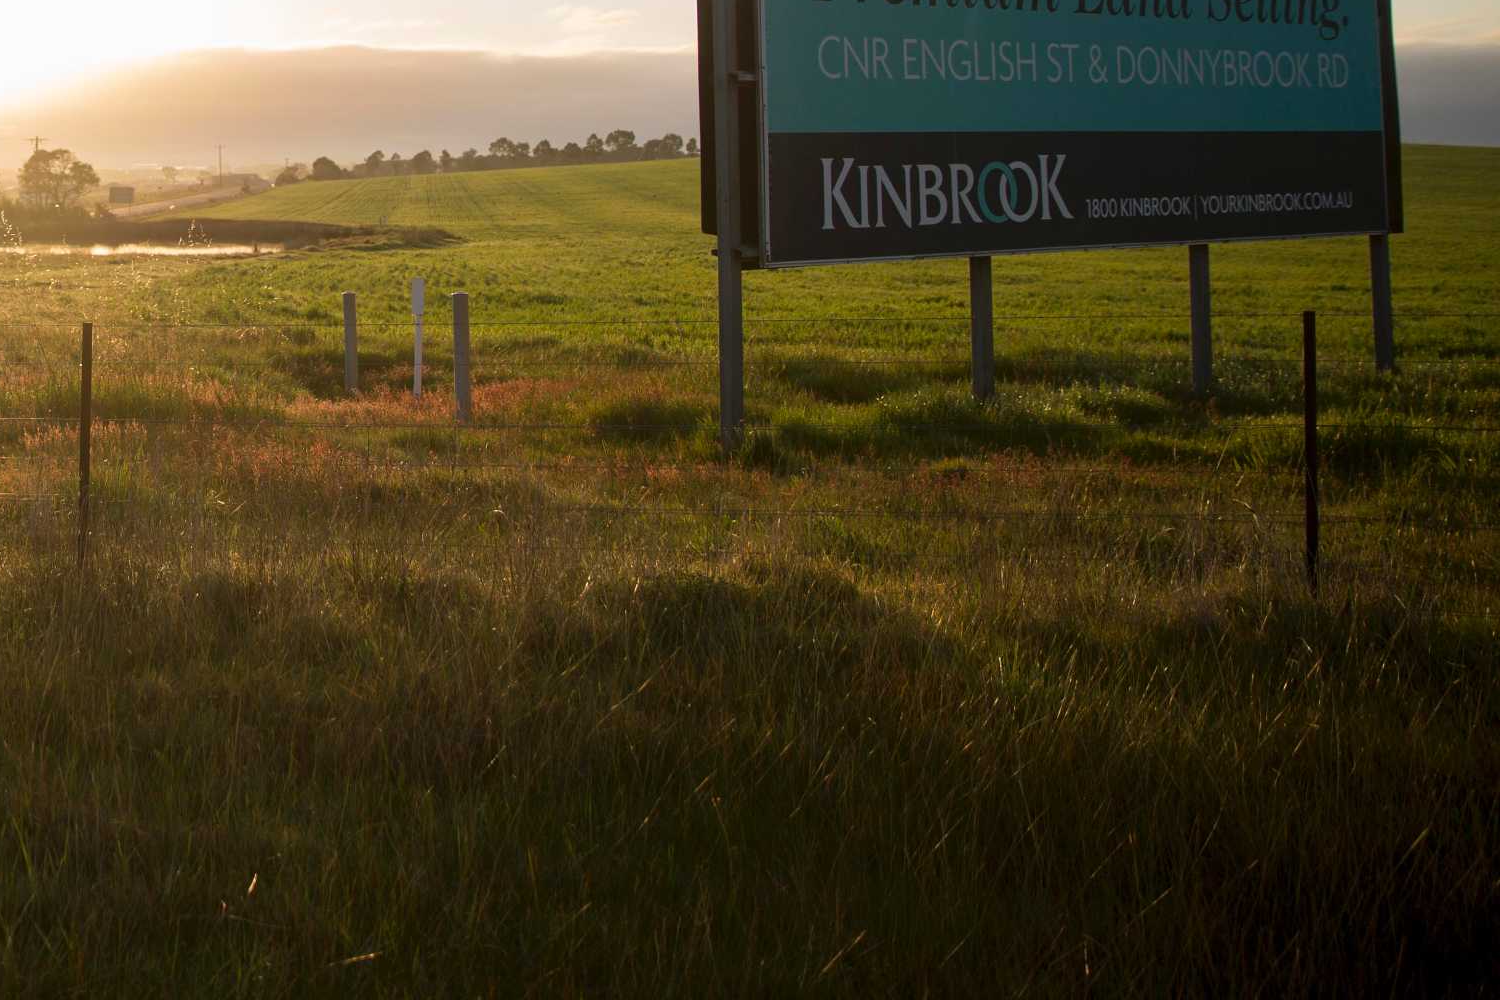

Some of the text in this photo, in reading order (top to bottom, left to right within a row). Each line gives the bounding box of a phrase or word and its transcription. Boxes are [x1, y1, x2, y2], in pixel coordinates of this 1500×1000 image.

[817, 35, 1349, 88] CNR ENGLISH ST & DONNYBROOK RD
[820, 153, 1075, 230] KINBROOK
[1085, 191, 1354, 219] 1800 KINBROOK YOURKINBROOK.COM.AU
